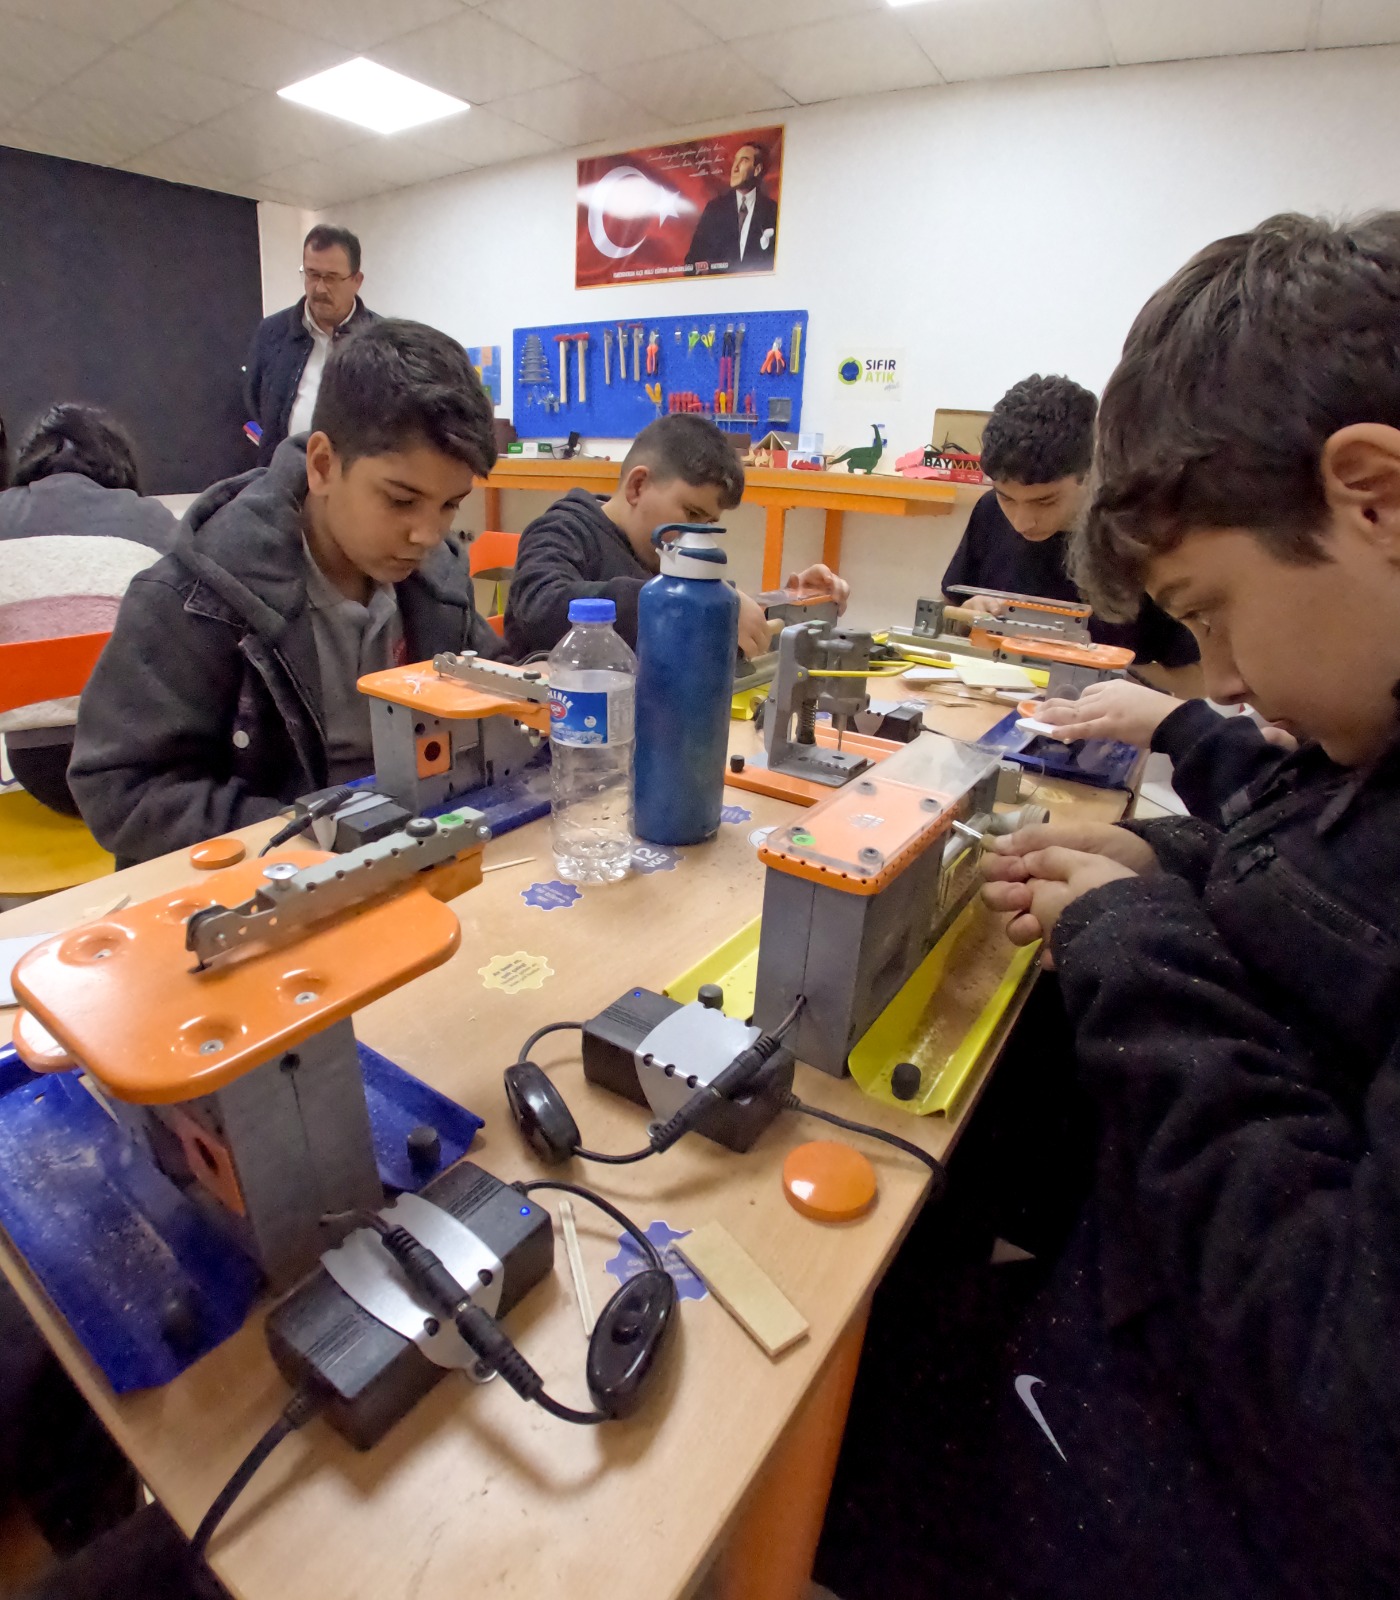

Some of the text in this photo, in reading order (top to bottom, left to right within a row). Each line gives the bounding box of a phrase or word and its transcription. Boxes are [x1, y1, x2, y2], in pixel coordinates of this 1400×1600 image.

[866, 359, 896, 371] SIFIR
[865, 370, 895, 383] ATIK
[632, 847, 660, 862] 12
